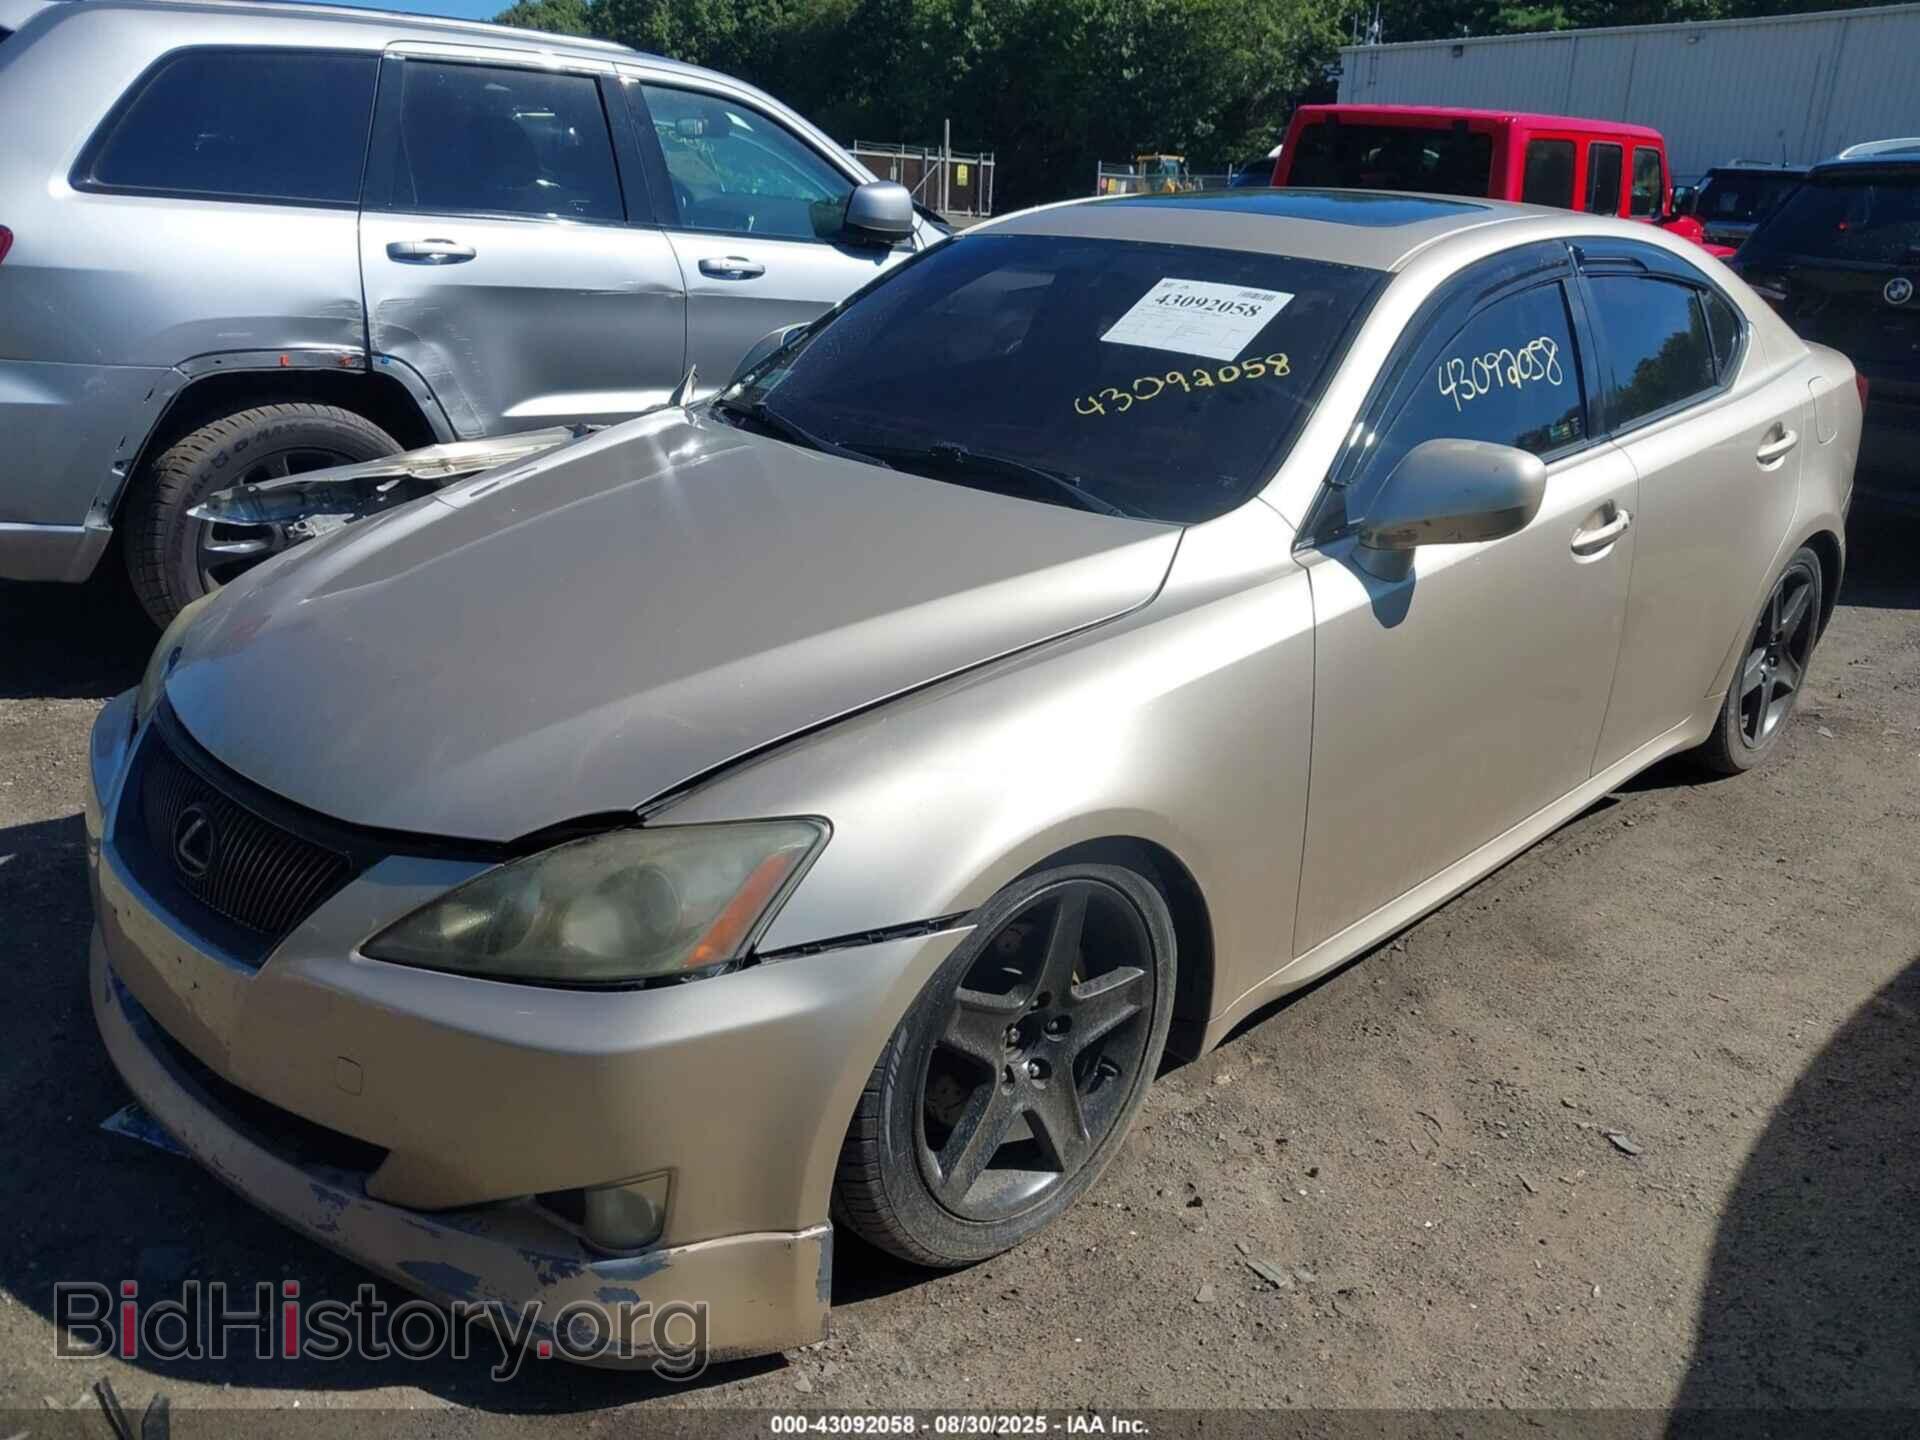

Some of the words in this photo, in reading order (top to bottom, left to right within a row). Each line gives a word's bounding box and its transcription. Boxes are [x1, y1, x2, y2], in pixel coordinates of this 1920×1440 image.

[1154, 294, 1263, 318] 43092058
[1074, 352, 1291, 416] 43092058
[1438, 336, 1564, 412] 43092058
